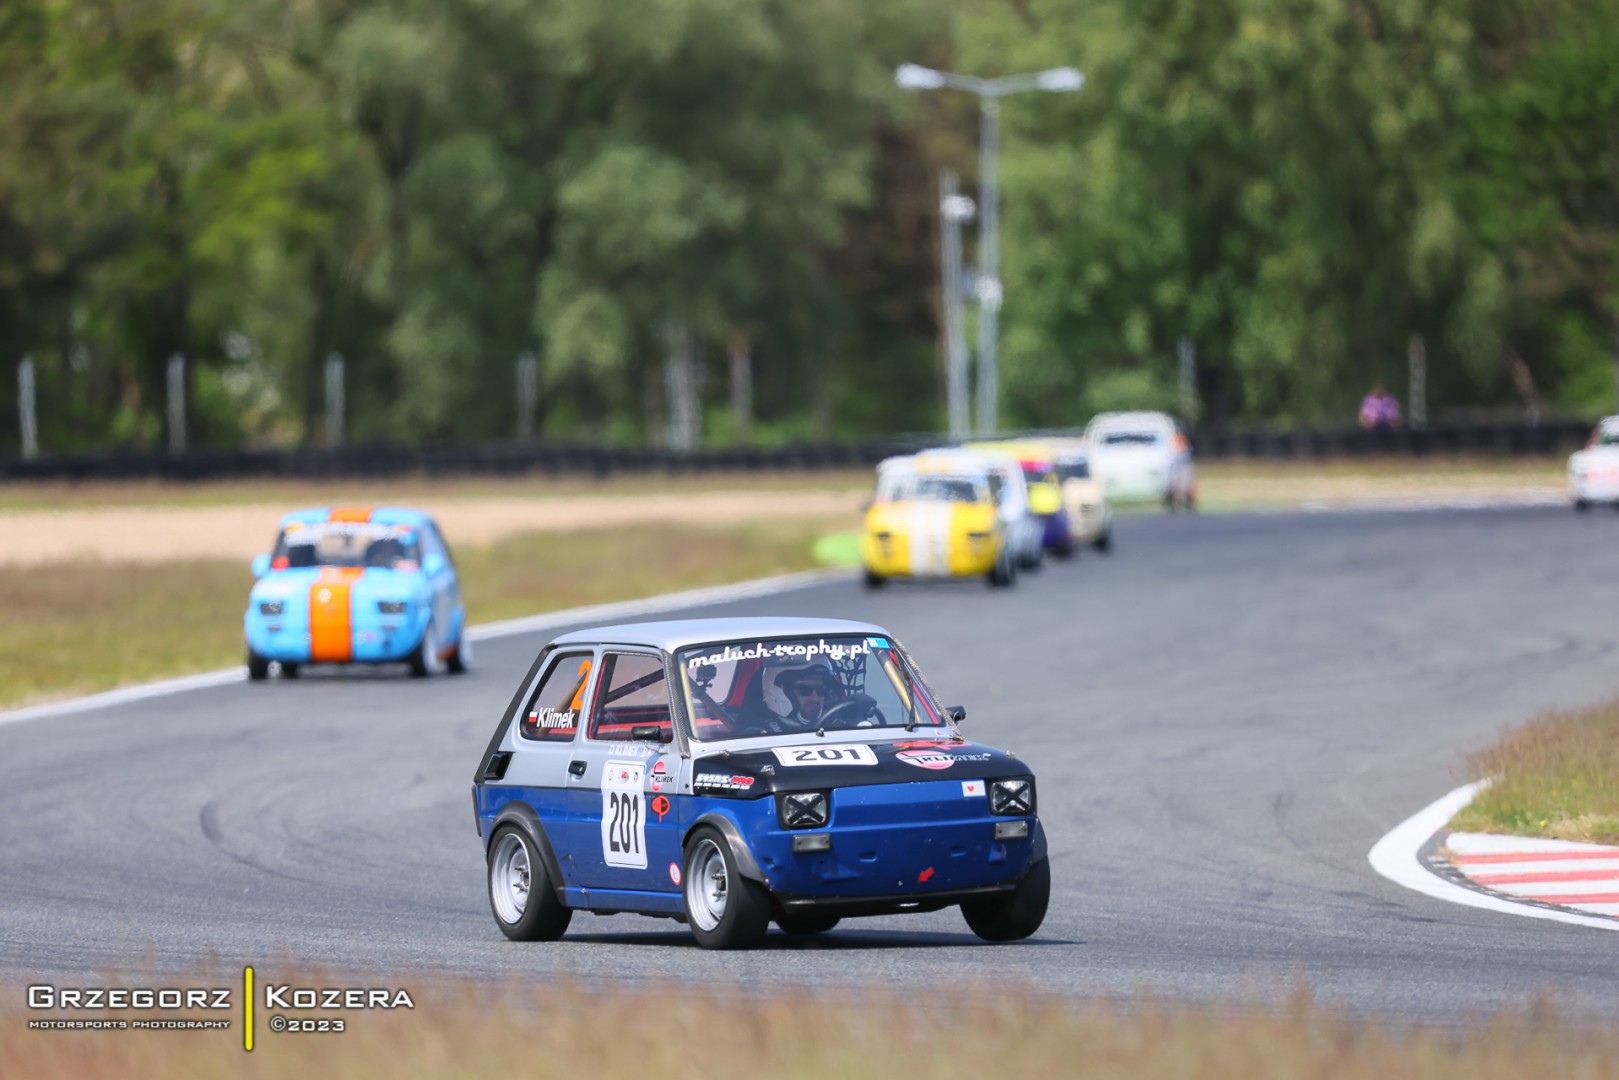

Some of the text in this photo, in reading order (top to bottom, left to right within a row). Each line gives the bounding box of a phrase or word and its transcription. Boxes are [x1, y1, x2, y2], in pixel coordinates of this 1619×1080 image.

[688, 640, 870, 668] maluch-trophy.pl
[536, 707, 576, 729] Klimek
[795, 748, 861, 762] 201
[609, 791, 640, 854] 201
